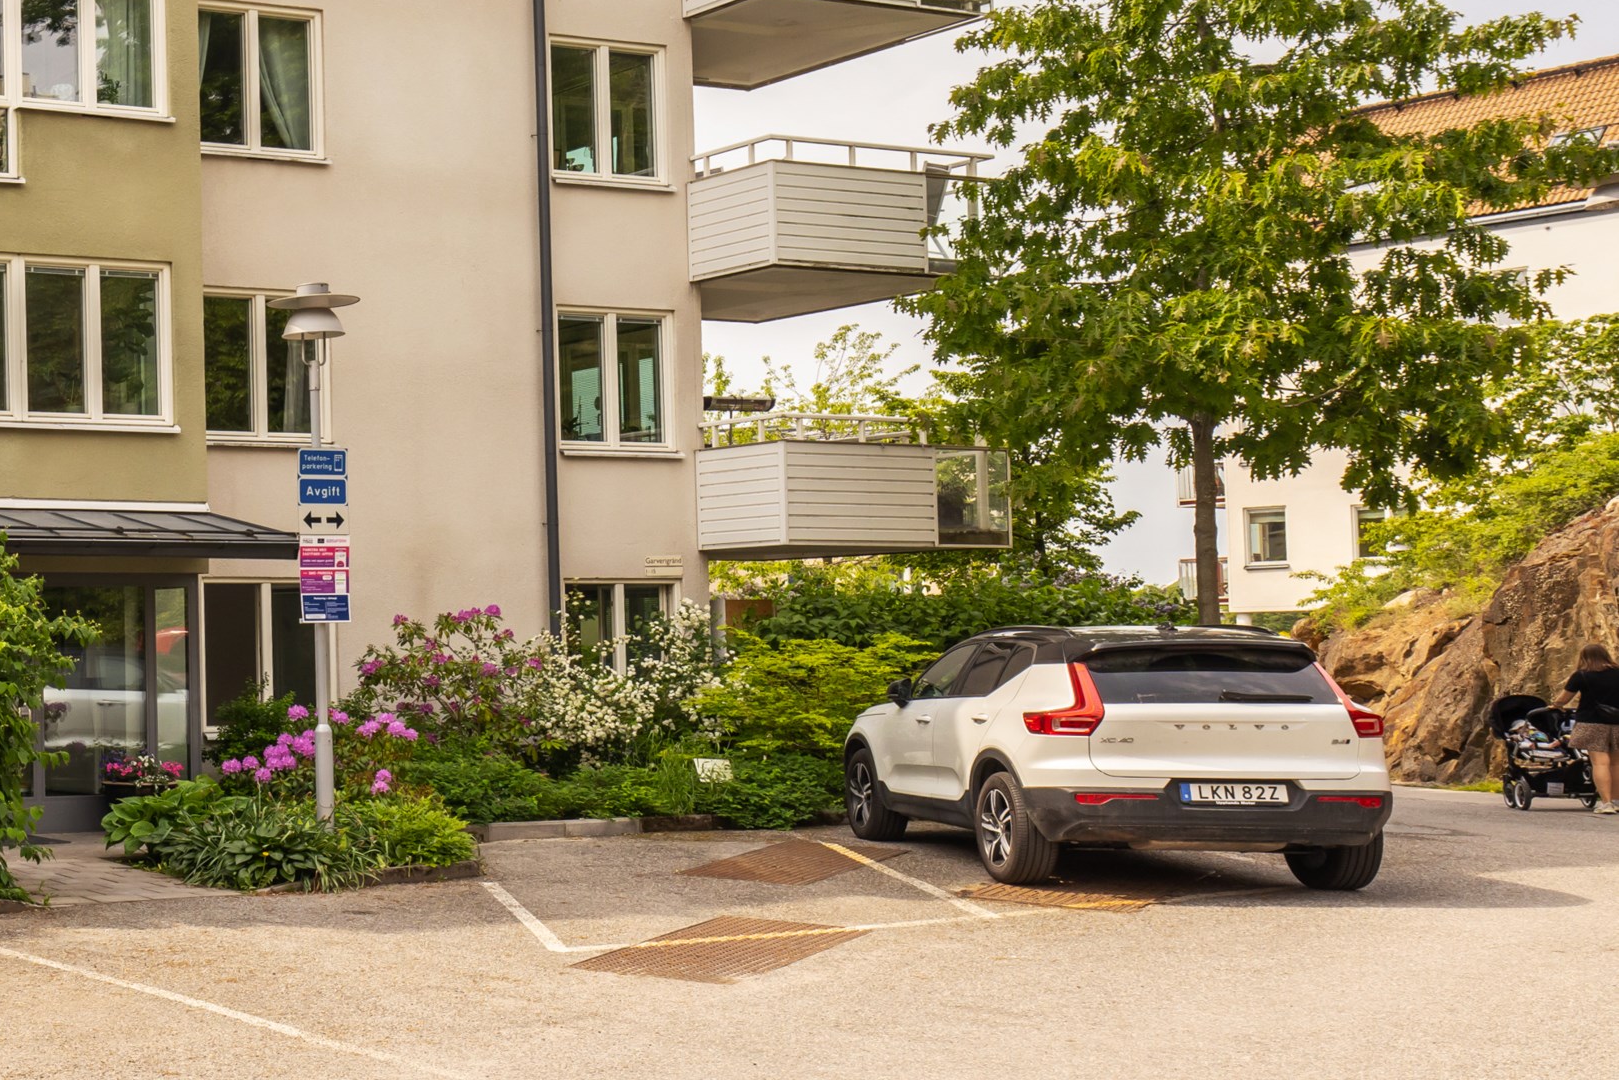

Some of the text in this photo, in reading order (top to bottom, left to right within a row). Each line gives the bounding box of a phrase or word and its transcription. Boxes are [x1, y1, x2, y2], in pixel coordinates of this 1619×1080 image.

[302, 463, 332, 471] parkering
[306, 486, 340, 498] Avgift
[1198, 786, 1235, 800] LKN
[1242, 786, 1279, 800] 82Z
